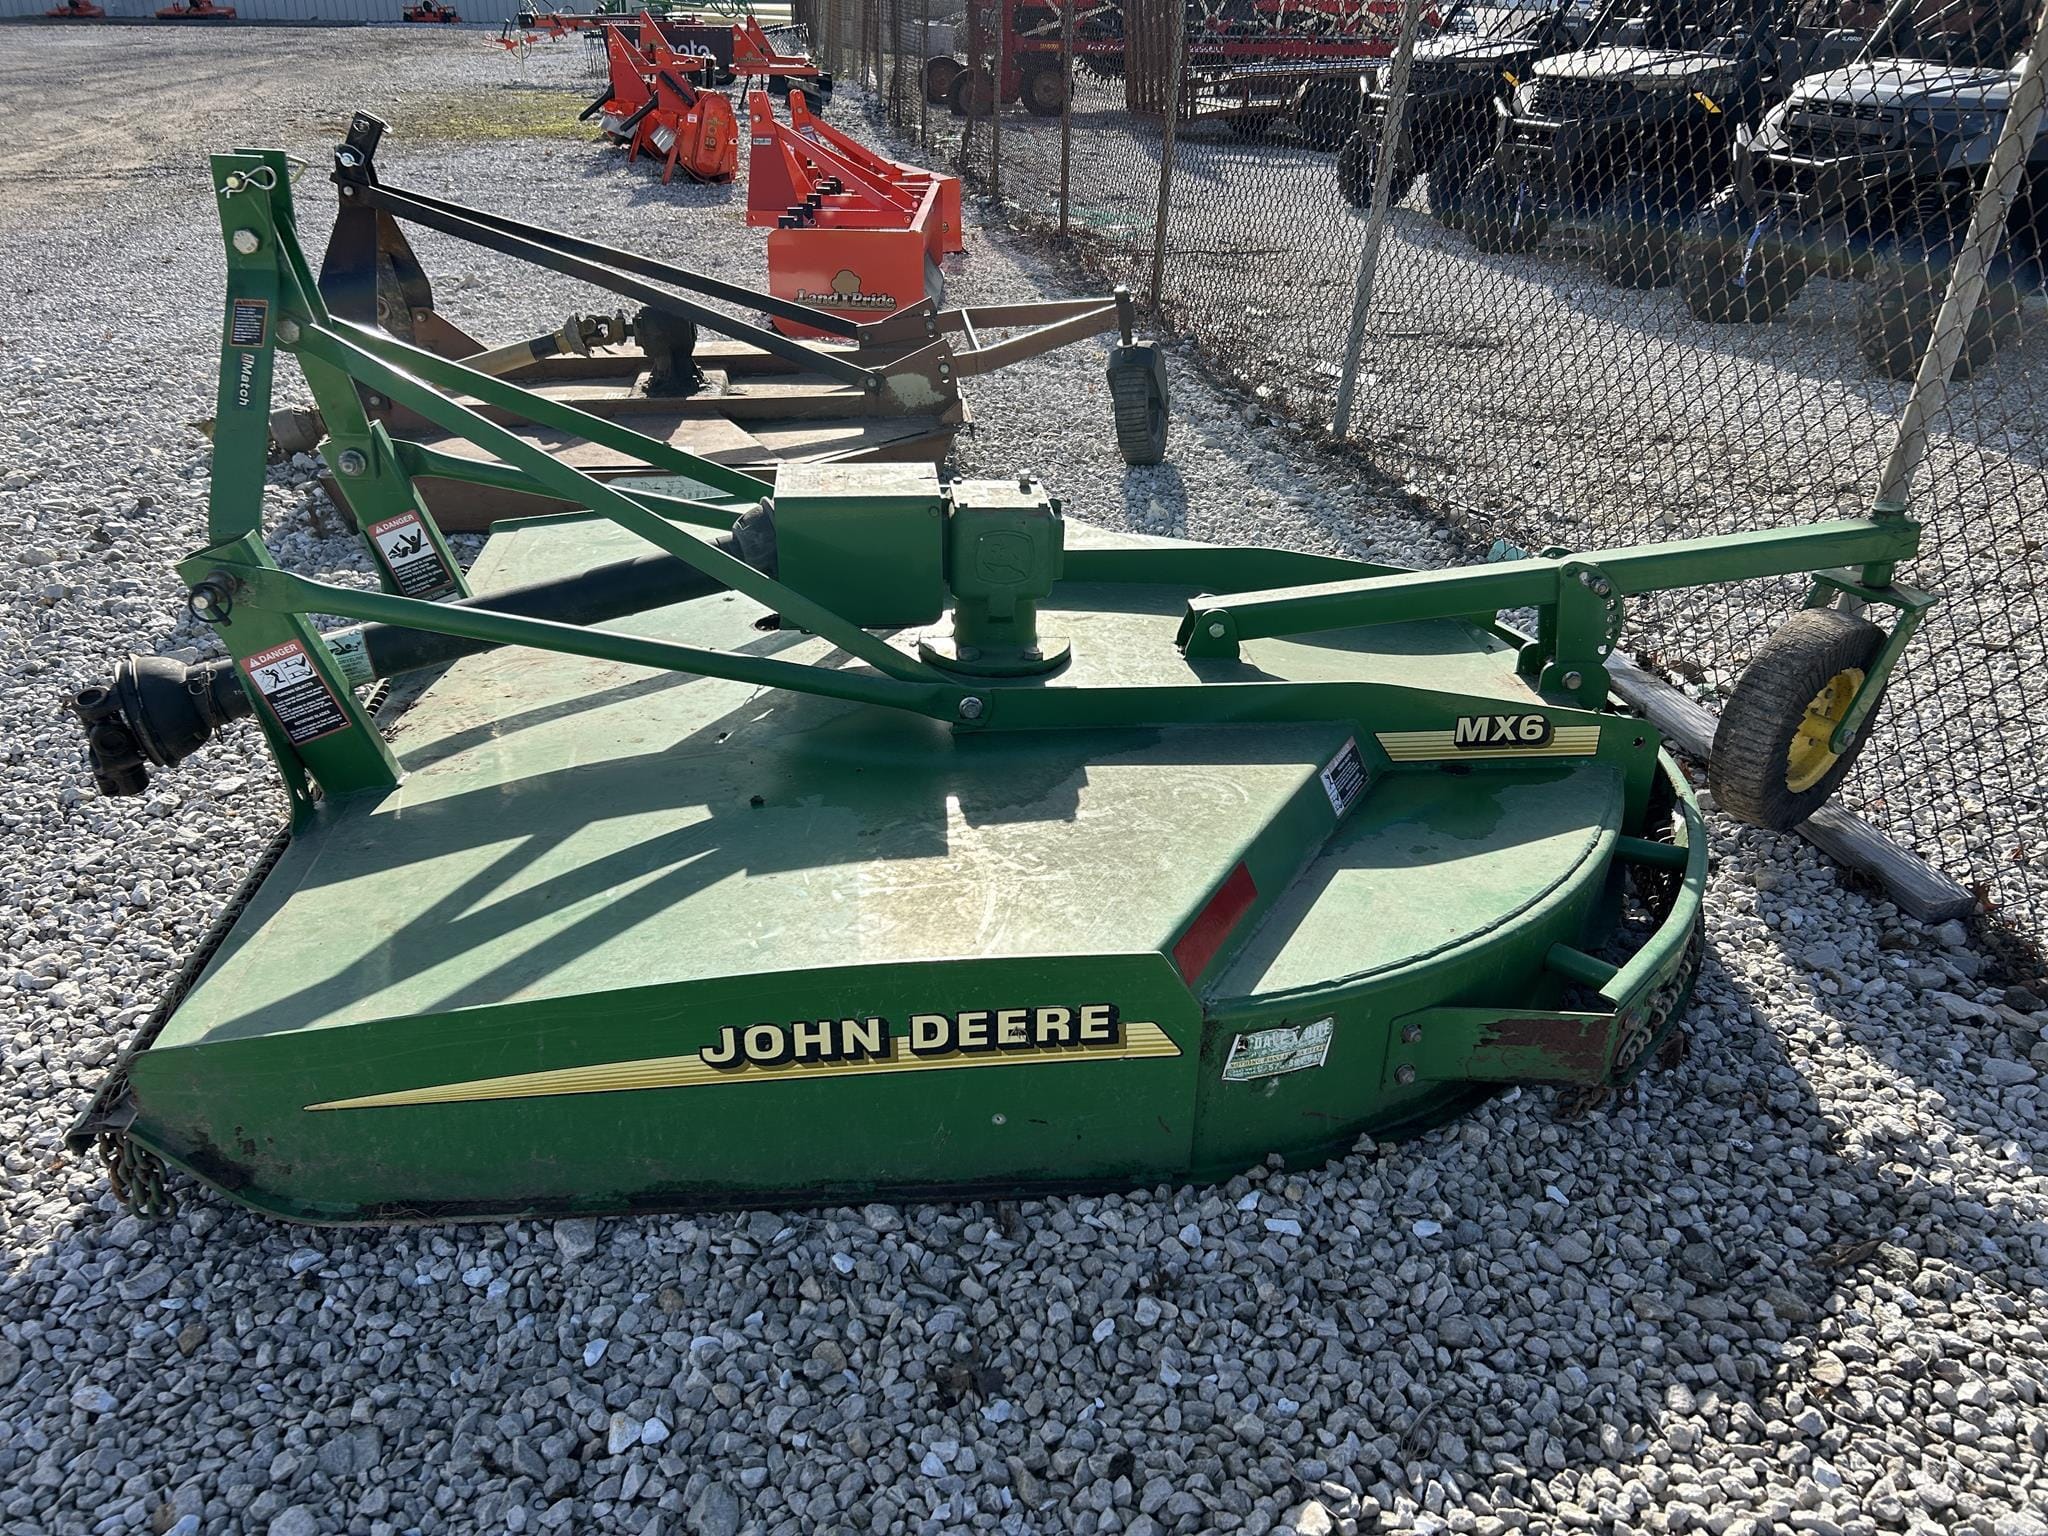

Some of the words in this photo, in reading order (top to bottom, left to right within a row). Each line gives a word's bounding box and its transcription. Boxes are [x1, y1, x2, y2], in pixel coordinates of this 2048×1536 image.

[796, 289, 839, 305] Land
[851, 292, 897, 307] Pride
[382, 514, 415, 530] DANGER
[258, 643, 298, 664] DANGER
[1454, 714, 1553, 749] MX6
[701, 1016, 889, 1069] JOHN
[910, 1003, 1118, 1056] DEERE
